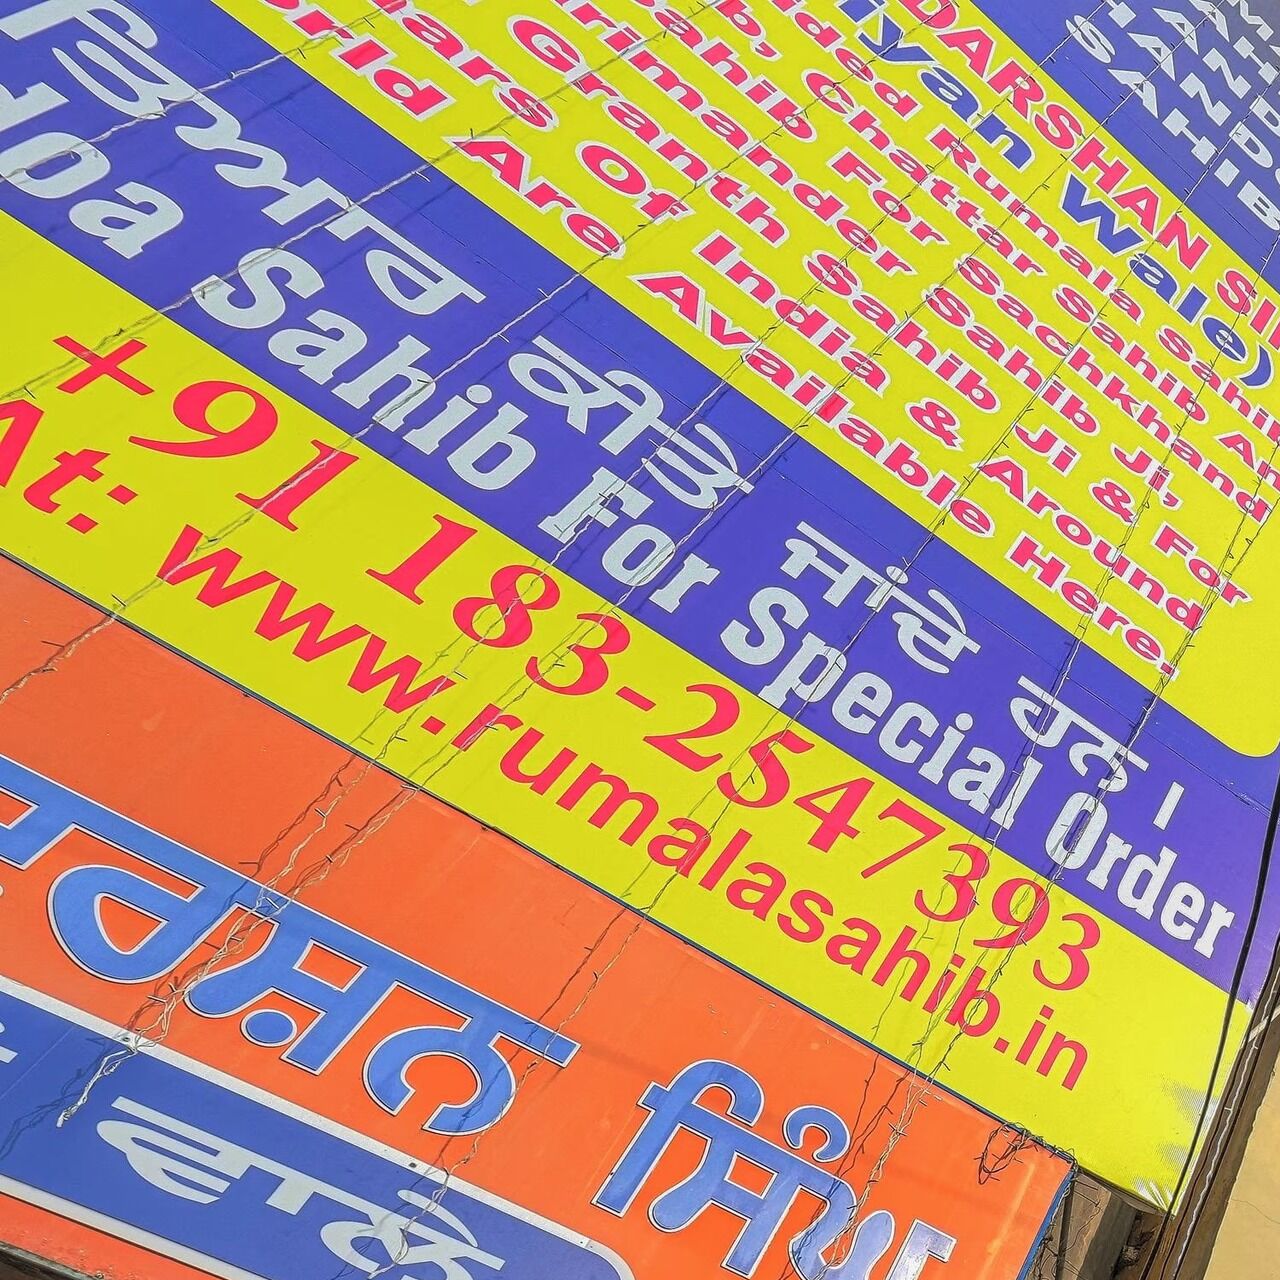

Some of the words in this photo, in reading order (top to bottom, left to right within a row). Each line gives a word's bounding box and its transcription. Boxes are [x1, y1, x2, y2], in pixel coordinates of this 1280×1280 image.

[438, 134, 628, 260] Are
[624, 270, 998, 540] Available
[1003, 530, 1182, 683] Here.
[506, 14, 790, 247] Granth
[800, 248, 1003, 412] Sahib
[1014, 420, 1080, 478] Ji
[1088, 477, 1140, 528] &
[1150, 521, 1254, 608] For
[574, 140, 696, 226] Of
[690, 229, 893, 400] India
[904, 396, 964, 454] &
[968, 453, 1206, 635] Around
[800, 68, 1047, 276] Chattar
[1052, 282, 1210, 424] Sahib
[826, 146, 950, 245] For
[953, 254, 1270, 524] Sachkhand
[920, 282, 1102, 438] Sahib
[1109, 441, 1182, 510] Ji,
[925, 122, 1142, 325] Rumala
[1058, 170, 1274, 390] Wale)
[155, 523, 1091, 1091] www.rumalasahib.in
[190, 246, 538, 493] Sahib
[536, 466, 720, 614] For
[718, 585, 1042, 832] Special
[1043, 792, 1238, 960] Order
[364, 513, 1103, 993] 183-2547393
[1008, 675, 1152, 792] ਹਨ
